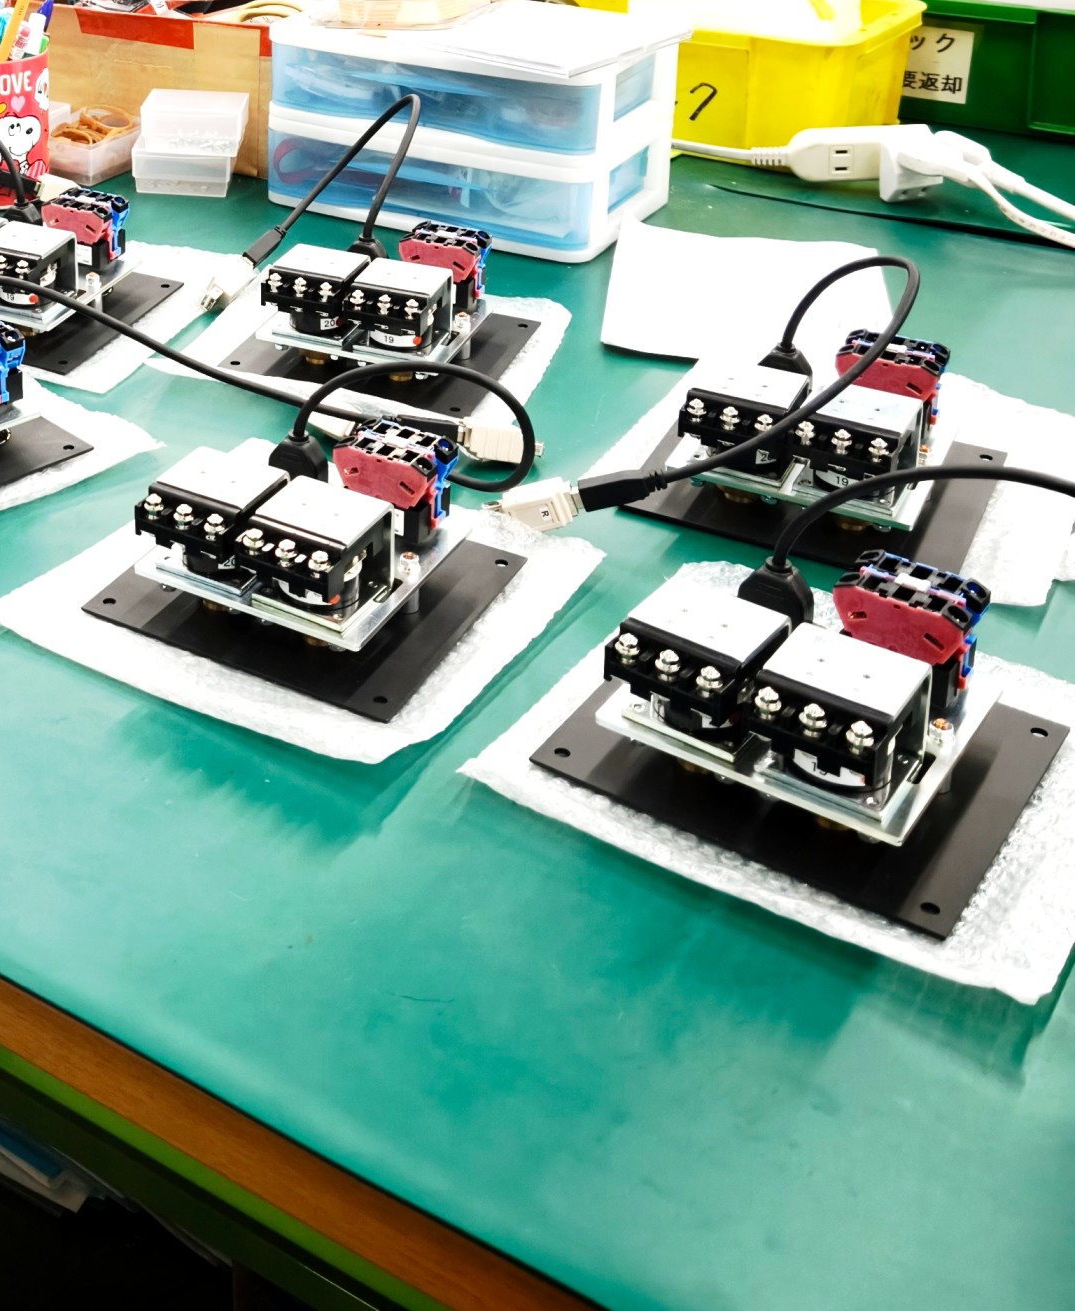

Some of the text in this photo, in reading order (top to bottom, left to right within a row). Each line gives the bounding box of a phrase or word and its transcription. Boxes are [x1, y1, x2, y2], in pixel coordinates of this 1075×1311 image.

[910, 33, 955, 53] ック
[902, 70, 963, 94] 要返却
[5, 292, 15, 301] 19
[324, 319, 336, 327] 20
[384, 334, 394, 344] 19
[836, 476, 849, 486] 19
[541, 509, 550, 518] R
